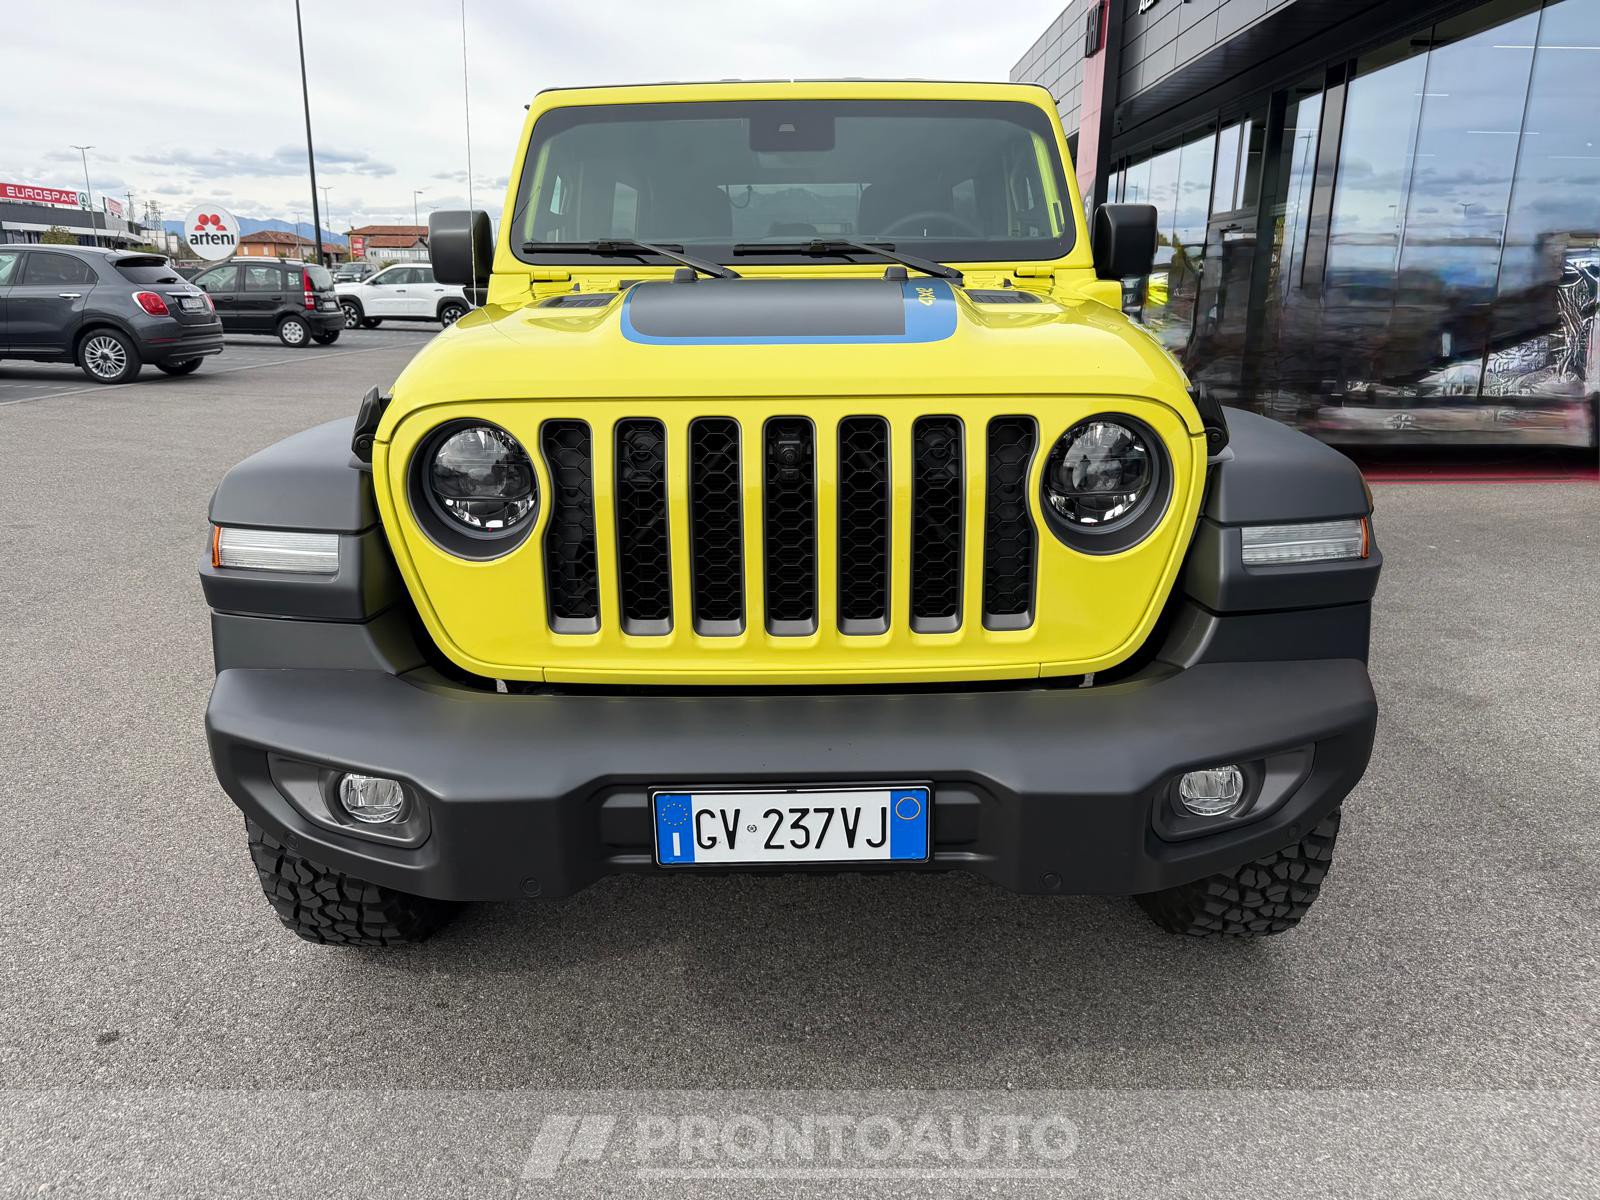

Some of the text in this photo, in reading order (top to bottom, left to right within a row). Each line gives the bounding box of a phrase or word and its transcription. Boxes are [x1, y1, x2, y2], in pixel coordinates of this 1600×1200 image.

[6, 186, 77, 203] EUROSPAR
[190, 232, 235, 245] arteni
[695, 806, 887, 850] GV 237VJ
